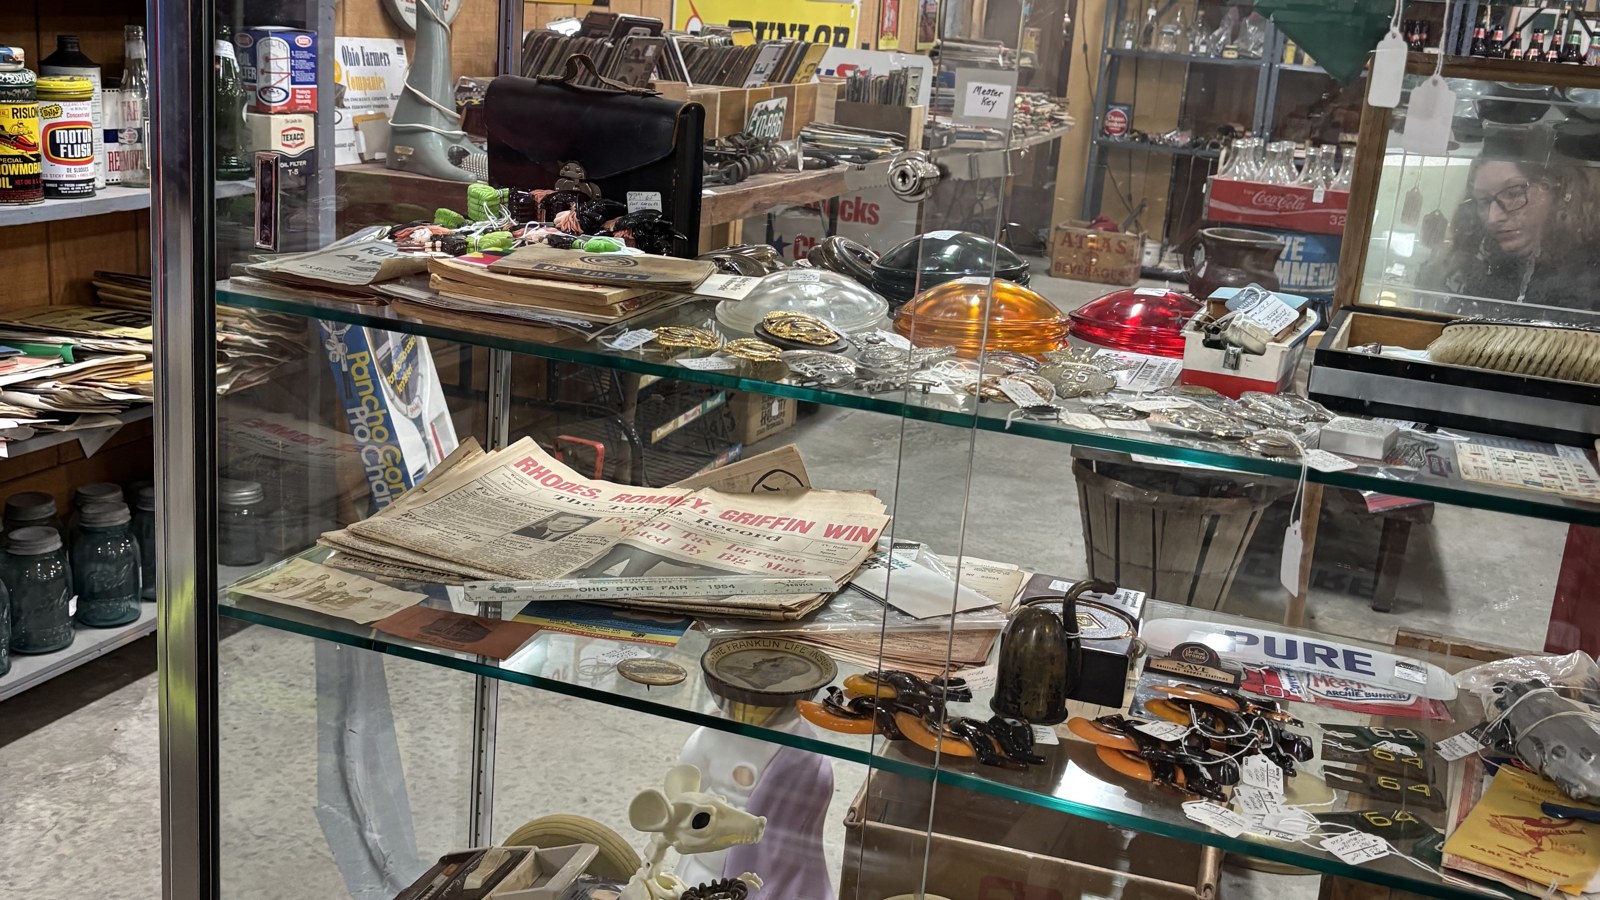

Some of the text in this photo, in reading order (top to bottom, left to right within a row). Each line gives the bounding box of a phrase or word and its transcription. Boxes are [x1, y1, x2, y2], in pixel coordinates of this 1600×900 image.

[341, 45, 391, 67] Ohio Farmers
[241, 66, 257, 80] LTER
[345, 70, 387, 95] Companies
[980, 97, 998, 112] Key
[282, 132, 305, 142] TEXACO
[60, 143, 91, 158] FLUSH
[1060, 232, 1127, 255] ATAS
[1061, 368, 1091, 383] 65
[347, 350, 389, 443] Pancho
[346, 406, 372, 443] Pro
[513, 456, 878, 543] RHODES, ROMNEY, GRIFFIN WIN
[552, 494, 596, 507] The
[695, 518, 783, 542] Record
[680, 542, 708, 556] By
[716, 552, 752, 566] Big
[681, 529, 713, 547] Tax
[726, 543, 807, 564] Increase
[711, 647, 727, 660] THE
[727, 640, 780, 651] FRANKLIN
[784, 641, 809, 654] LIFE
[1225, 630, 1376, 677] PURE
[1176, 662, 1209, 674] SAVE
[1325, 689, 1364, 698] ARCHIE
[1470, 844, 1504, 858] CARL
